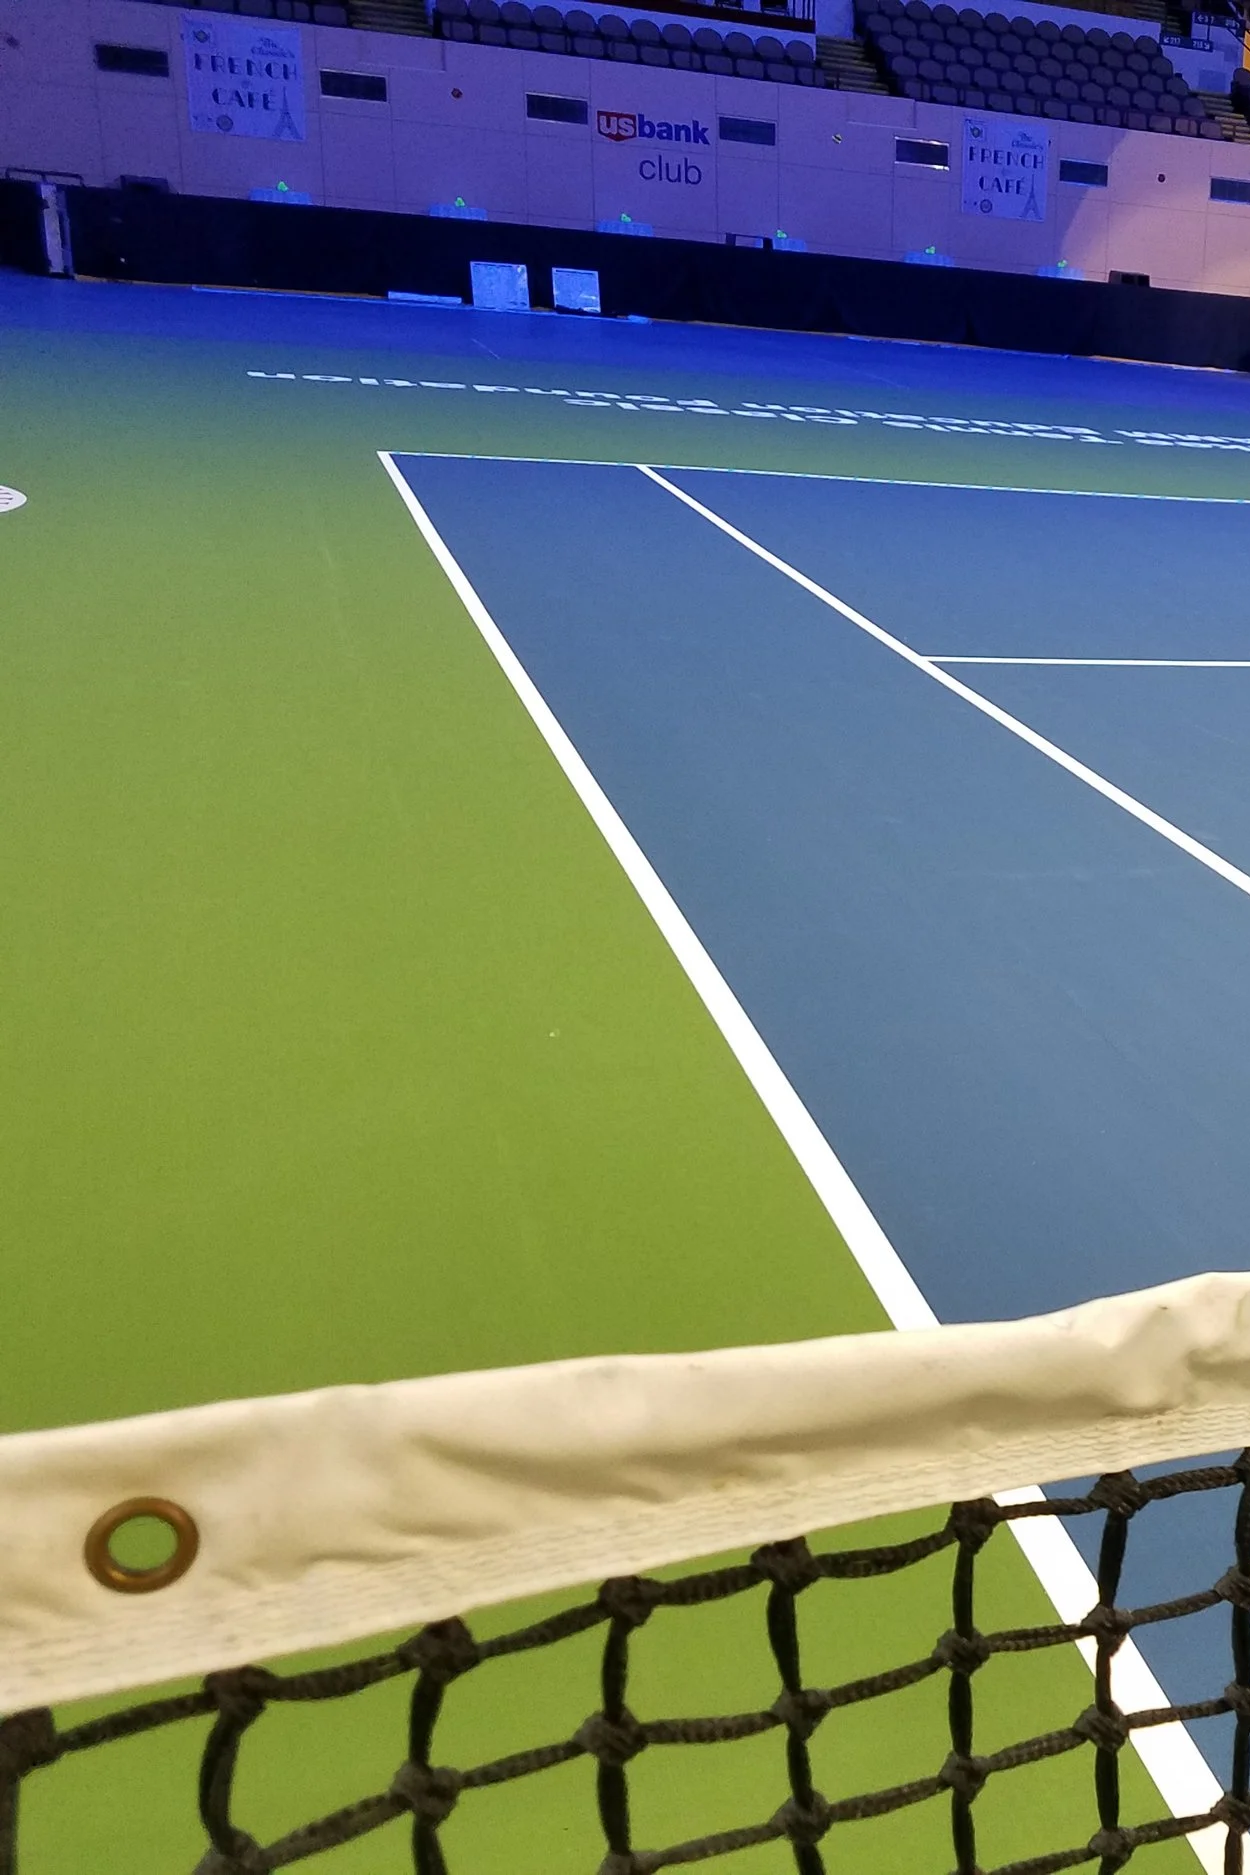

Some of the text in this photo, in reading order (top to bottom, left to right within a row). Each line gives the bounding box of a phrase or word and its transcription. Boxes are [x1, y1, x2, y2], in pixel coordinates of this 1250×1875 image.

[194, 52, 298, 81] FRENCH
[211, 87, 277, 112] CAFÉ
[639, 154, 702, 185] club
[968, 146, 1044, 170] FRENCH
[978, 176, 1026, 196] CAFÉ
[246, 371, 719, 408] Foundation
[563, 398, 859, 426] Classic
